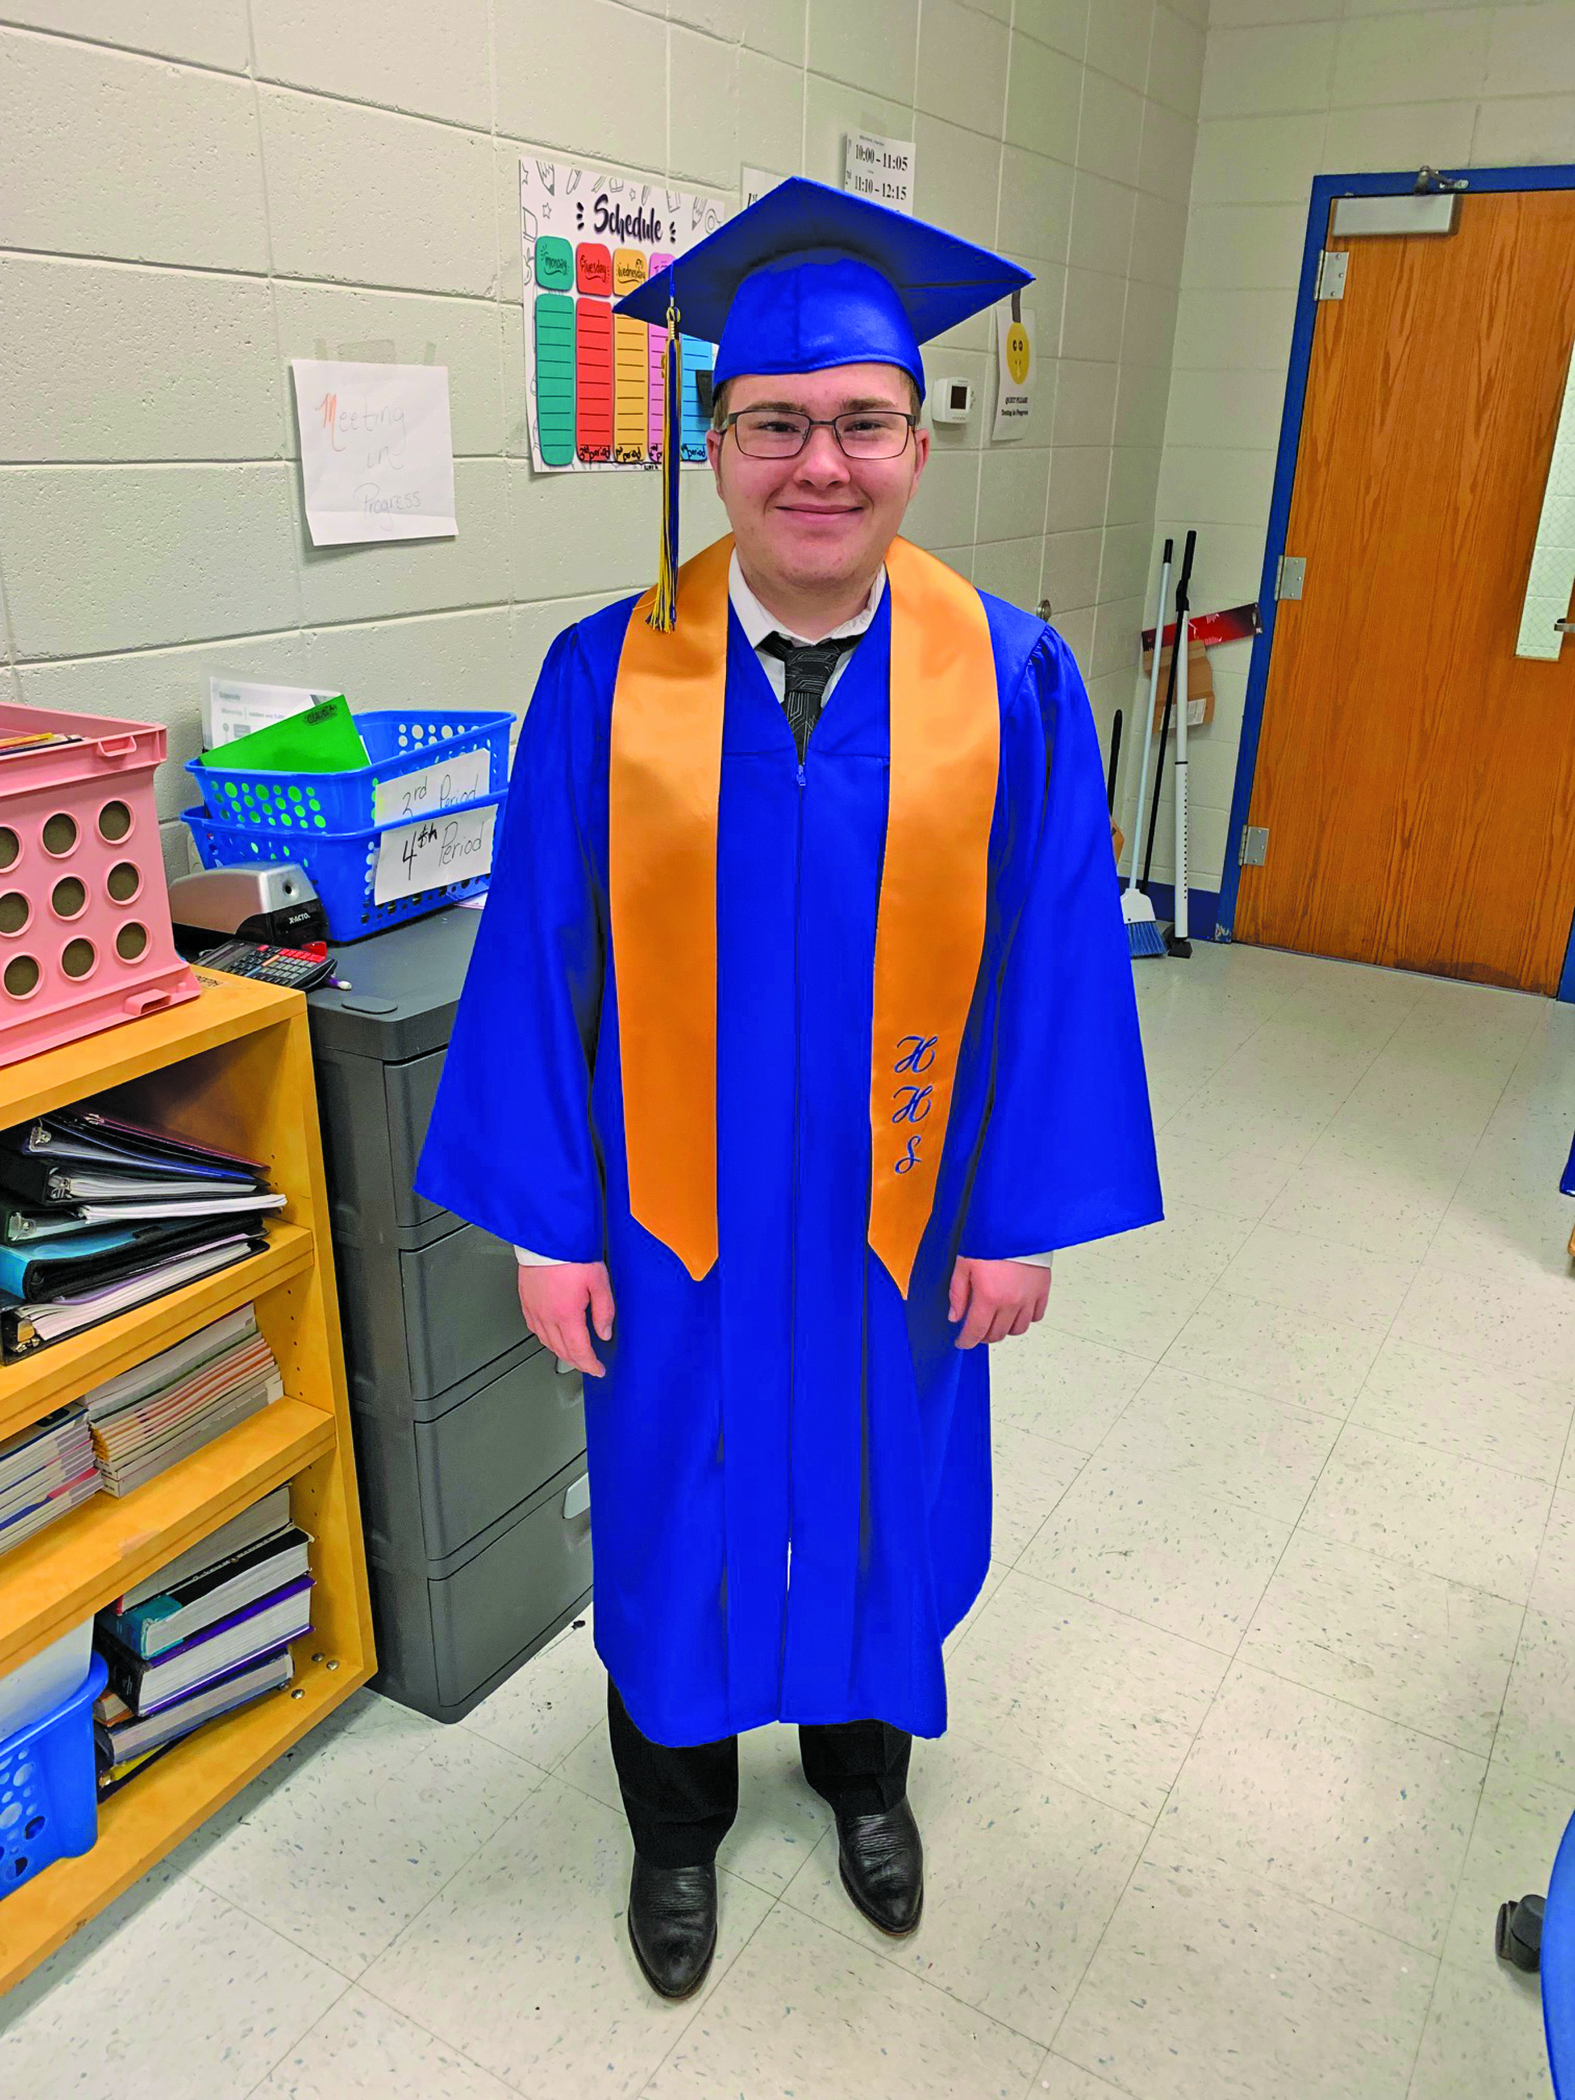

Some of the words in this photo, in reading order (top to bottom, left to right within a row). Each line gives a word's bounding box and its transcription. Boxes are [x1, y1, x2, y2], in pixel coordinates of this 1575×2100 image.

[856, 144, 875, 164] 10:00
[883, 152, 908, 171] 11:05
[855, 175, 873, 194] 11:10
[882, 183, 907, 200] 12:15
[593, 193, 664, 244] Schedule
[315, 392, 408, 456] Meeting
[366, 446, 404, 470] in
[353, 482, 422, 532] Progress
[440, 773, 479, 809] Period
[402, 821, 438, 881] 4th
[438, 821, 485, 867] Period
